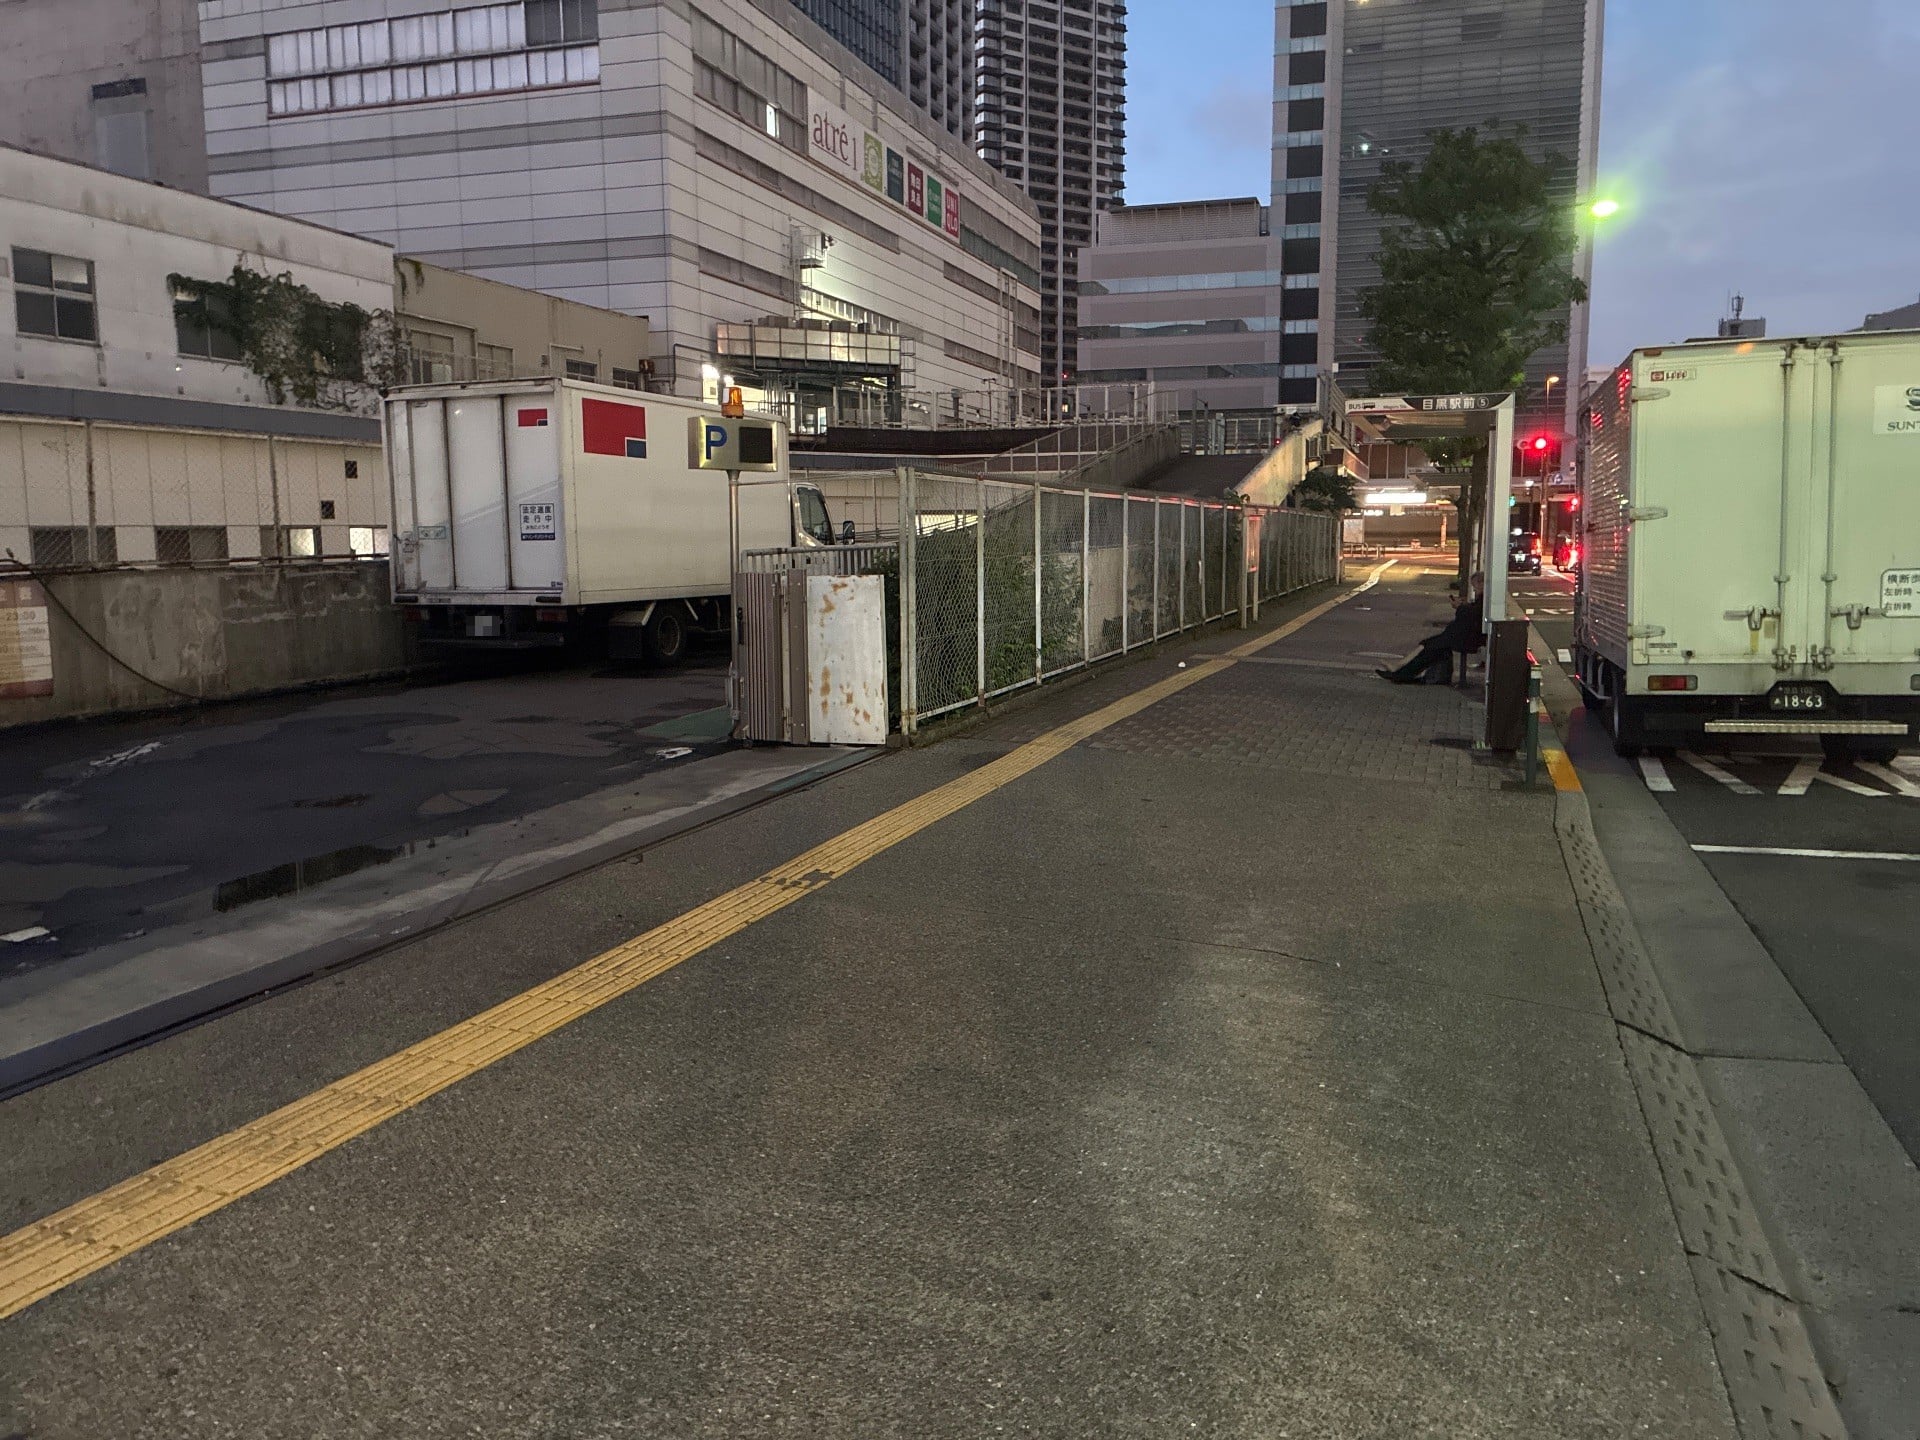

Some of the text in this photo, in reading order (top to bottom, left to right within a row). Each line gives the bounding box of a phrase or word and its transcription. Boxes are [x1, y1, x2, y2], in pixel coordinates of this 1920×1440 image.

[813, 111, 848, 161] atré
[946, 194, 957, 214] UNI
[1422, 397, 1475, 410] 目黒駅前
[706, 425, 727, 460] P
